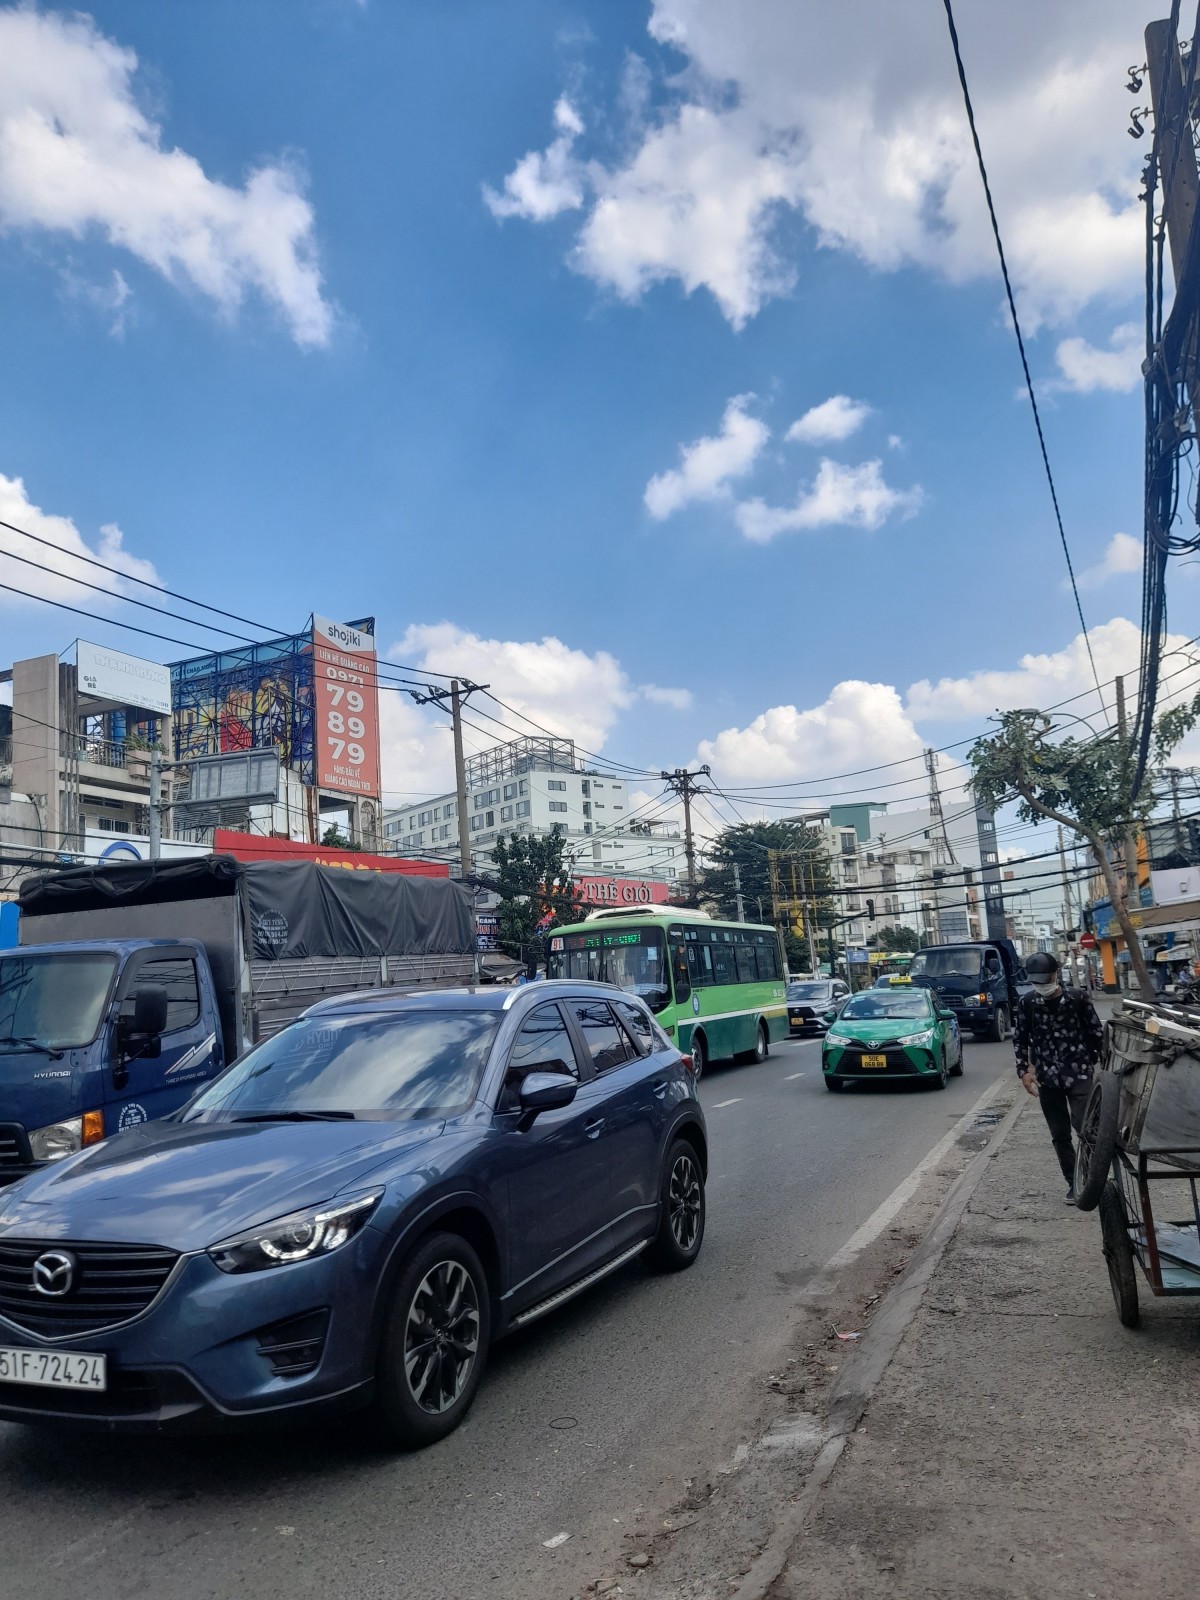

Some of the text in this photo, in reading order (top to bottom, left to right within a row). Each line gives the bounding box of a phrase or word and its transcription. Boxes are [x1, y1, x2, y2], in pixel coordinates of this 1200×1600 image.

[328, 625, 360, 647] shojiki
[326, 666, 364, 689] 0971
[358, 662, 370, 673] CÁO
[326, 683, 364, 713] 79
[327, 711, 366, 739] 89
[327, 736, 365, 765] 79
[585, 879, 618, 900] THẾ
[307, 1029, 338, 1045] HYUN
[33, 1071, 71, 1079] HYUNDAI
[0, 1350, 102, 1386] 51F-724.24
